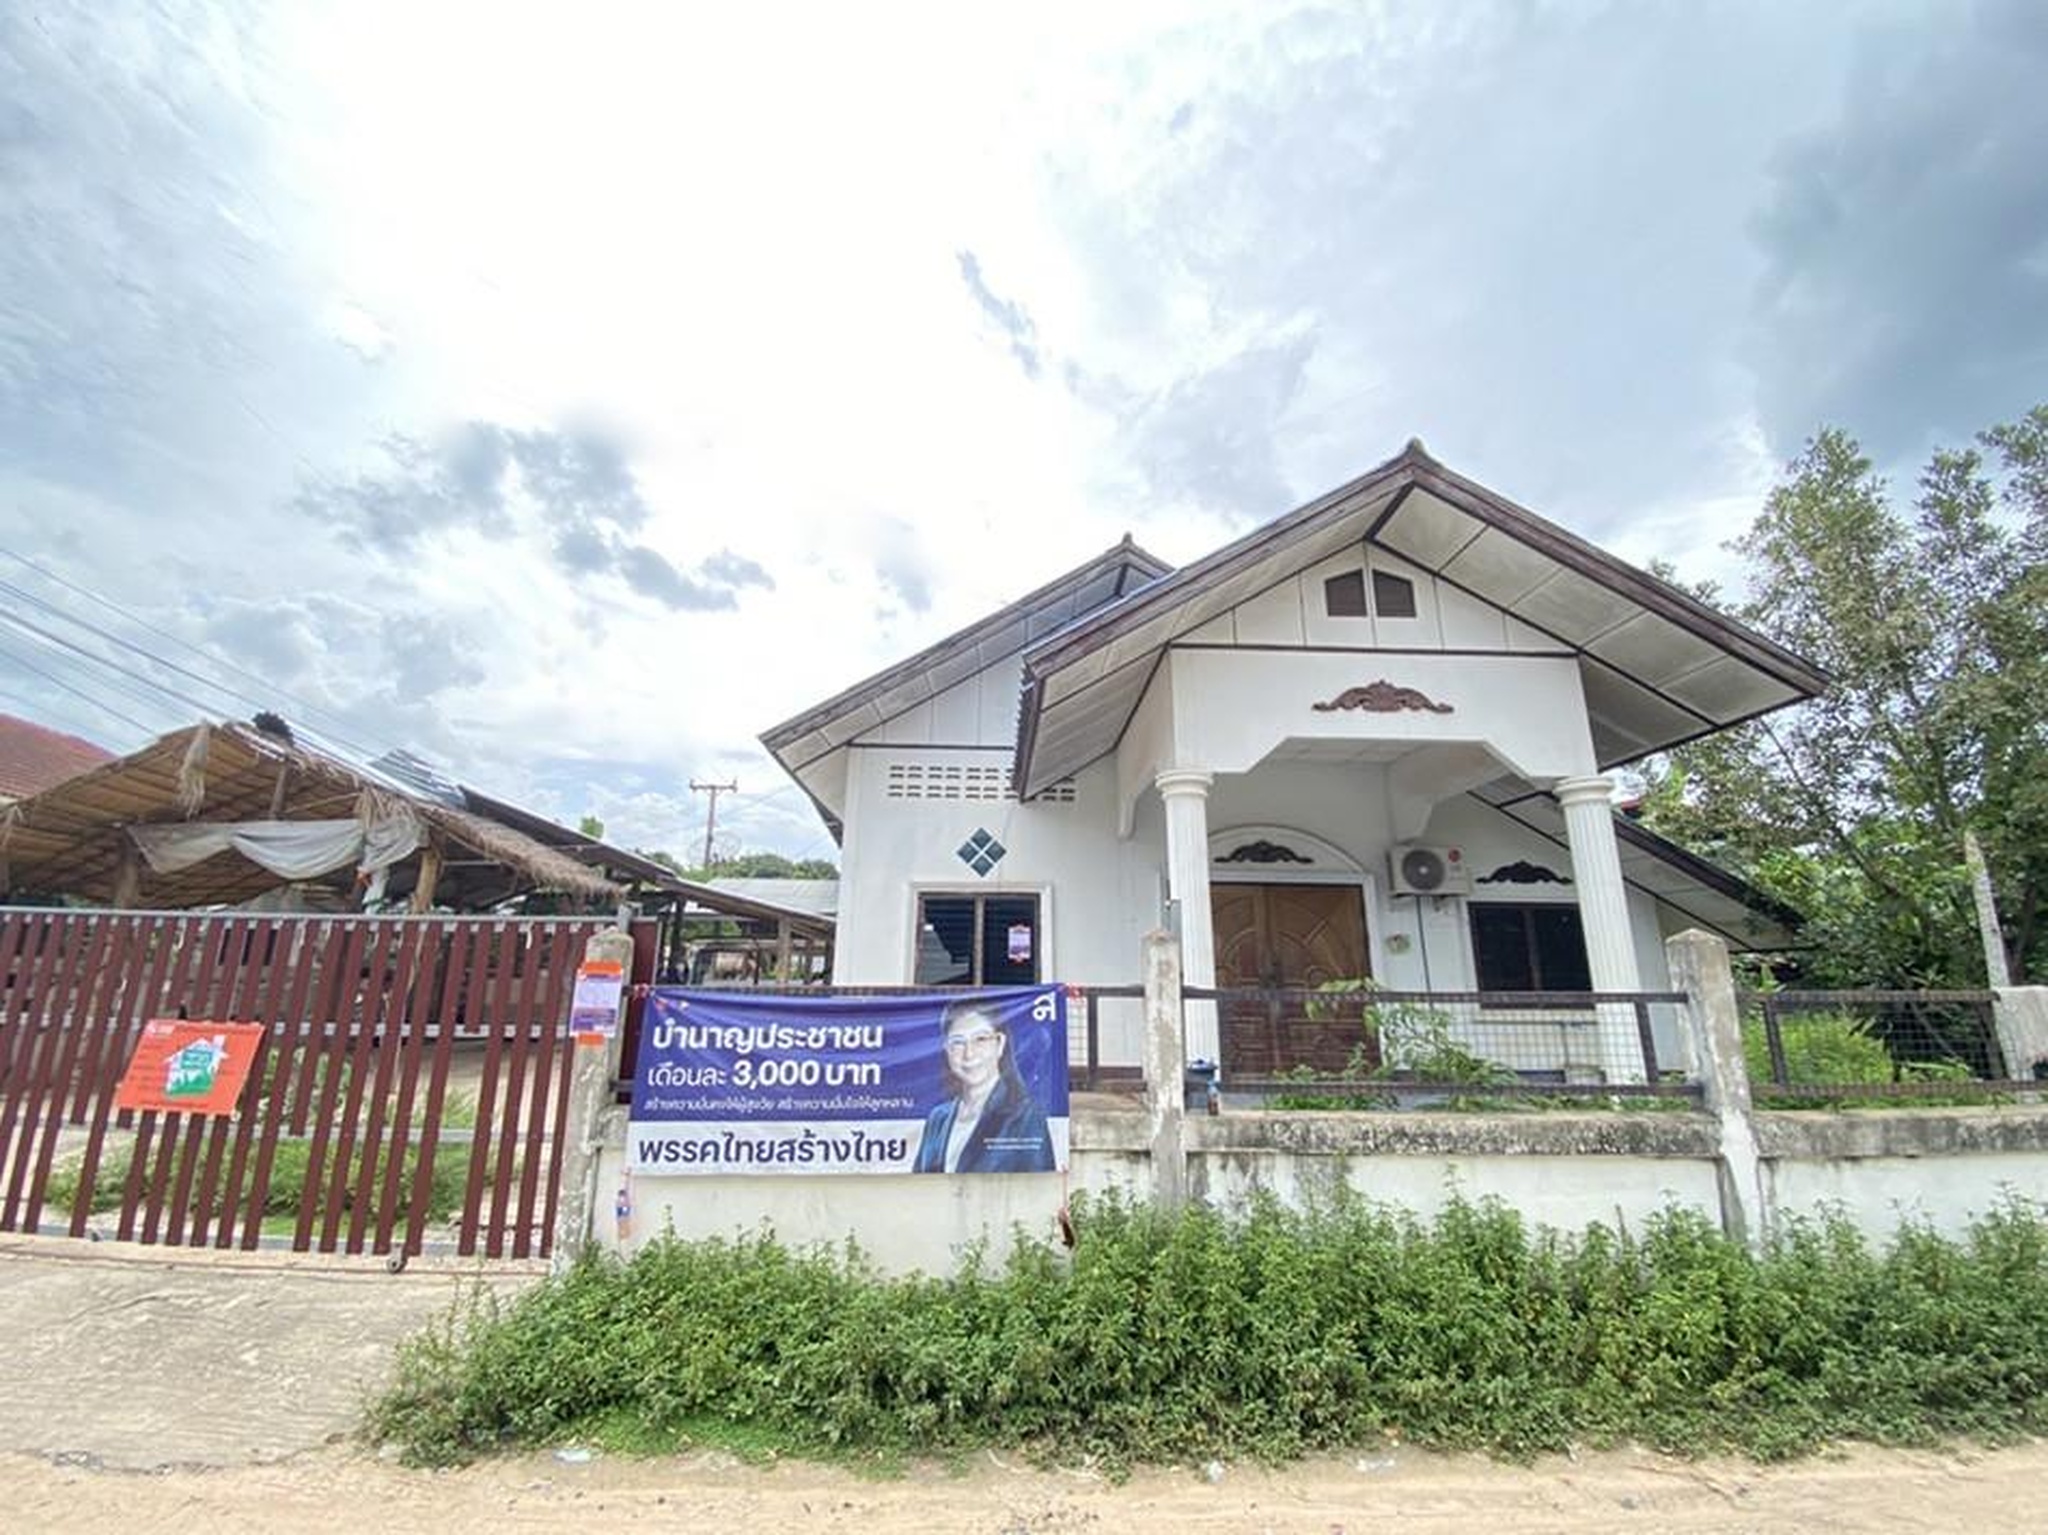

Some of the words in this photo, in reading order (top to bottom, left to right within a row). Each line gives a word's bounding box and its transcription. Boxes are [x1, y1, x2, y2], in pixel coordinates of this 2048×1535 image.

[652, 1017, 884, 1053] บำนาญประชาชน
[647, 1061, 727, 1087] เดือนละ
[732, 1059, 820, 1090] 3,000
[825, 1060, 881, 1085] บาท
[638, 1129, 908, 1163] พรรคไทยสร้างไทย
